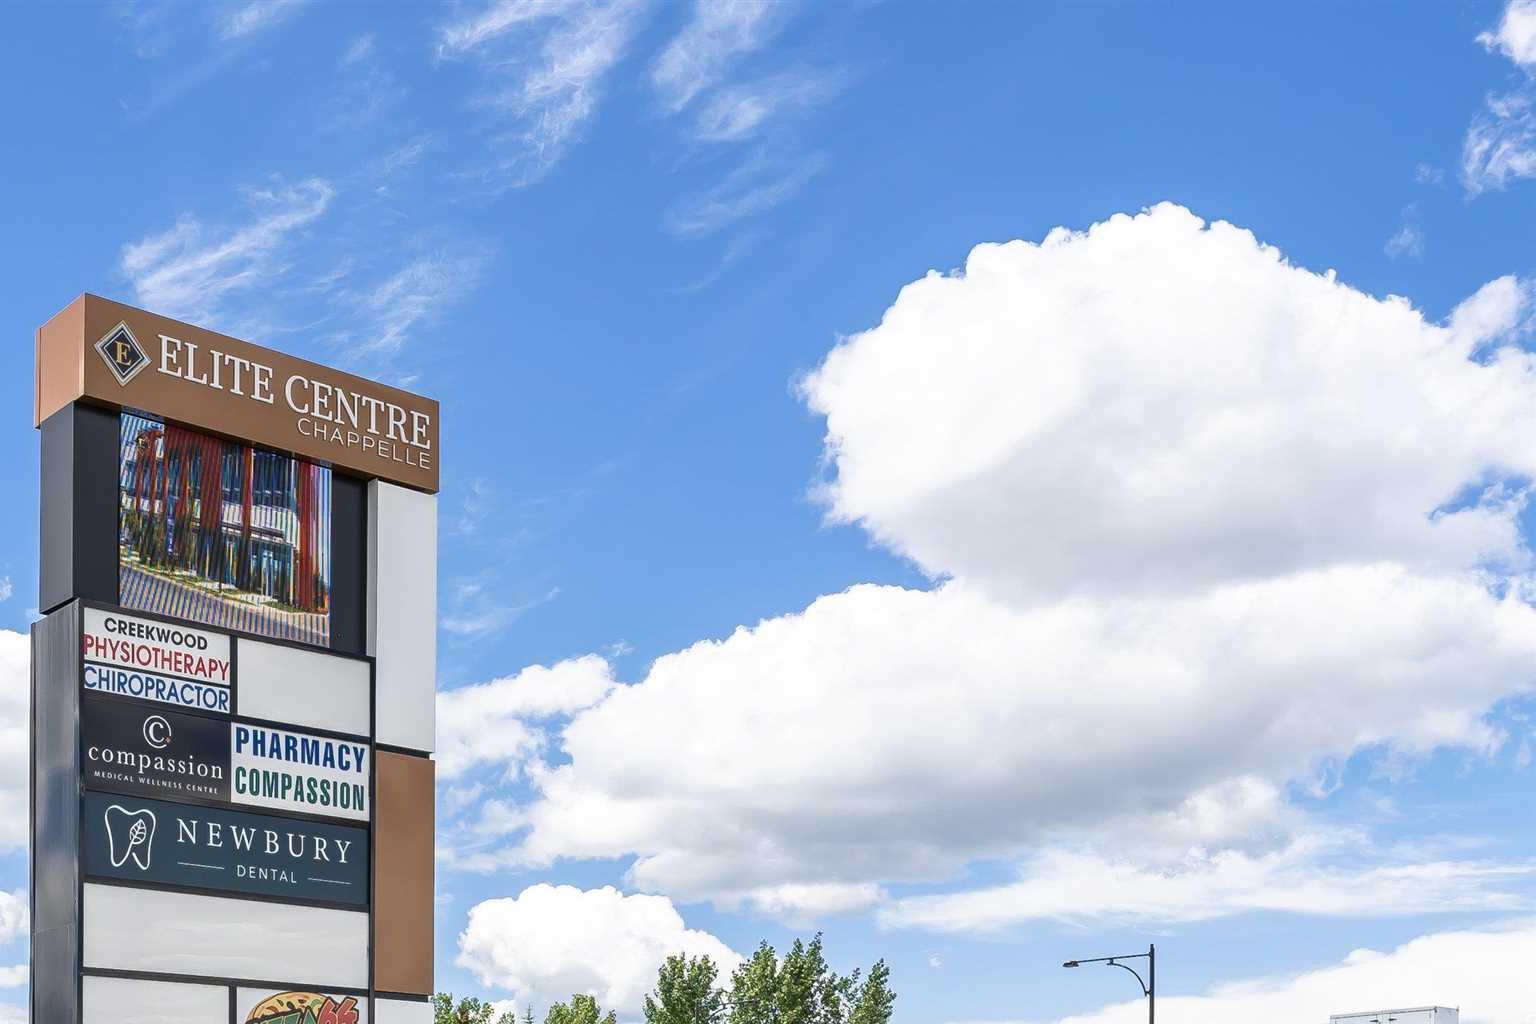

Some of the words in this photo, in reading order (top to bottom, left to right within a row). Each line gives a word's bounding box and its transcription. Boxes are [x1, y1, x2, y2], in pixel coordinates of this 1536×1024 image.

[157, 334, 274, 404] ELITE
[285, 375, 431, 450] CENTRE
[297, 418, 431, 470] CHAPPELLE
[104, 617, 208, 650] CREEKWOOD
[83, 633, 229, 681] PHYSIOTHERAPY
[83, 666, 229, 711] CHIROPRACTOR
[88, 746, 224, 779] compassion
[235, 726, 365, 773] PHARMACY
[94, 770, 134, 783] MEDICAL
[139, 777, 182, 790] WELLNESS
[186, 784, 218, 795] CENTRE
[235, 766, 365, 811] COMPASSION
[177, 818, 351, 864] NEWBURY
[237, 864, 297, 884] DENTAL
